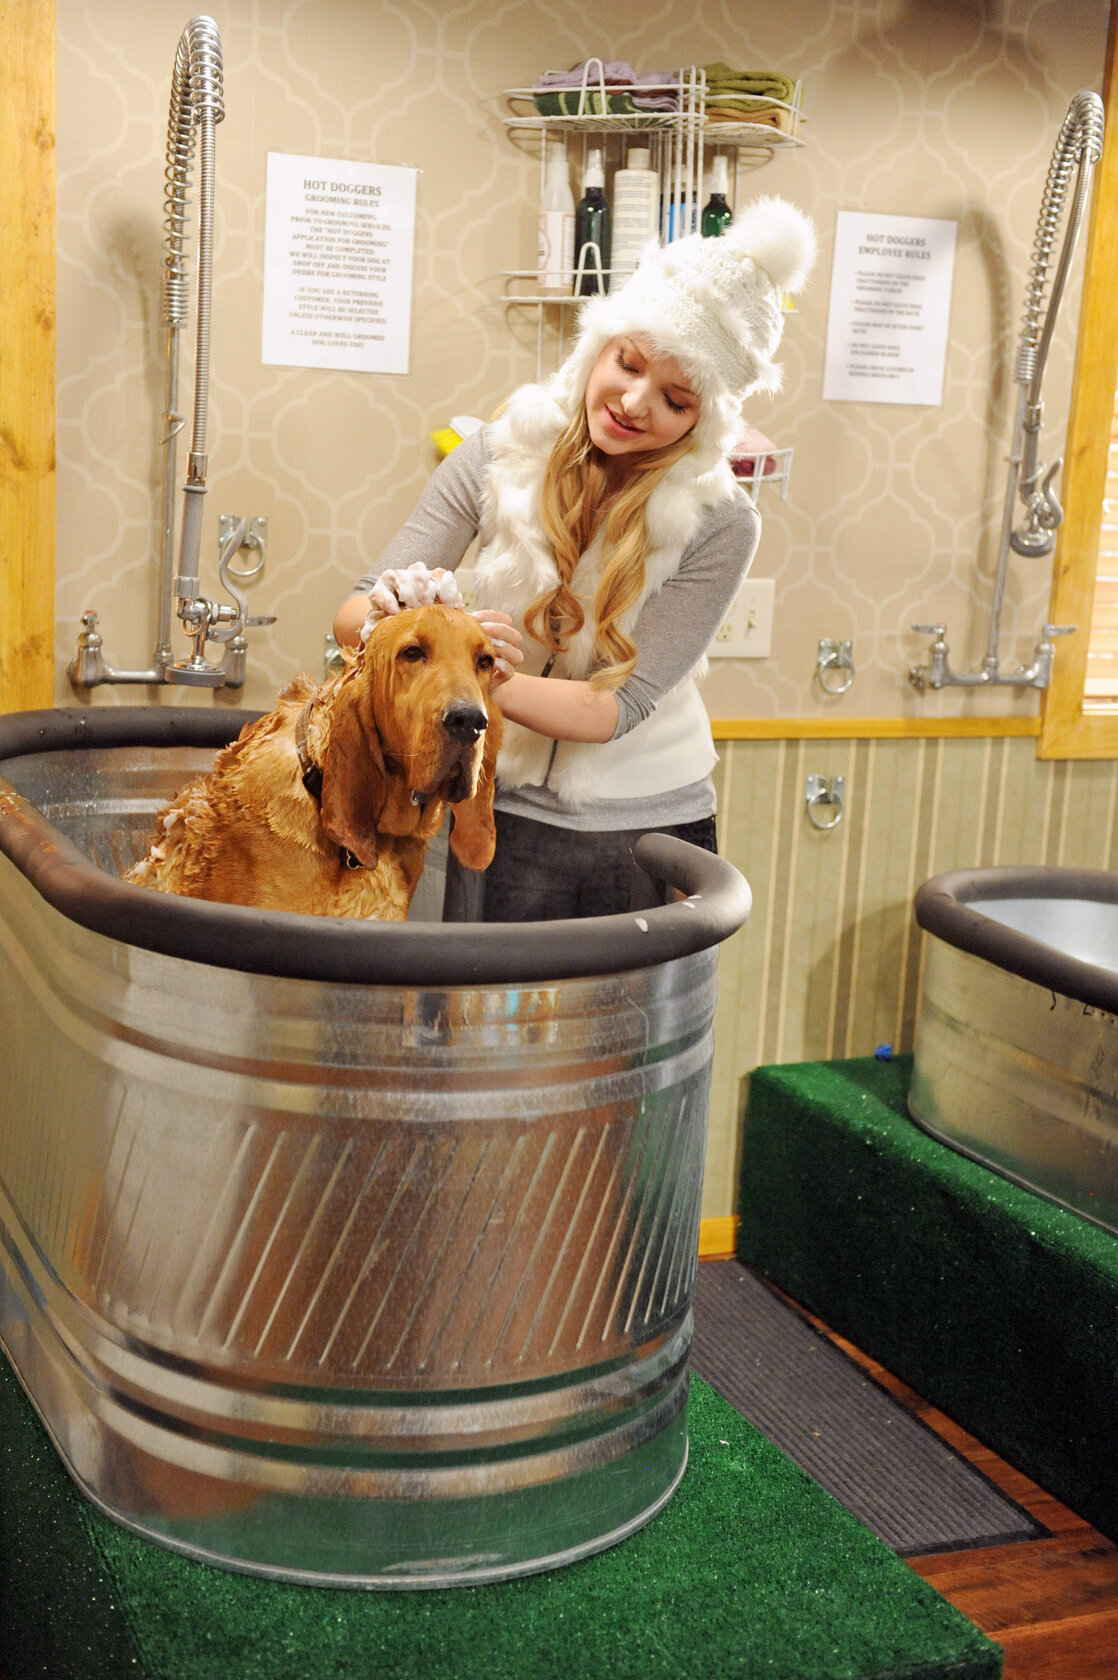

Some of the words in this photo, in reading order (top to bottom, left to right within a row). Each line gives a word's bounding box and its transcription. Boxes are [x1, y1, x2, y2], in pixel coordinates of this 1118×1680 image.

[304, 180, 327, 190] HOT
[331, 183, 382, 196] DOGGERS
[305, 194, 351, 205] GROOMING
[354, 199, 379, 207] RULES
[292, 234, 335, 243] APPLICATION
[867, 234, 885, 243] HOT
[887, 236, 926, 246] DOGGERS
[859, 246, 902, 257] EMPLOYEE
[905, 250, 931, 260] RULES
